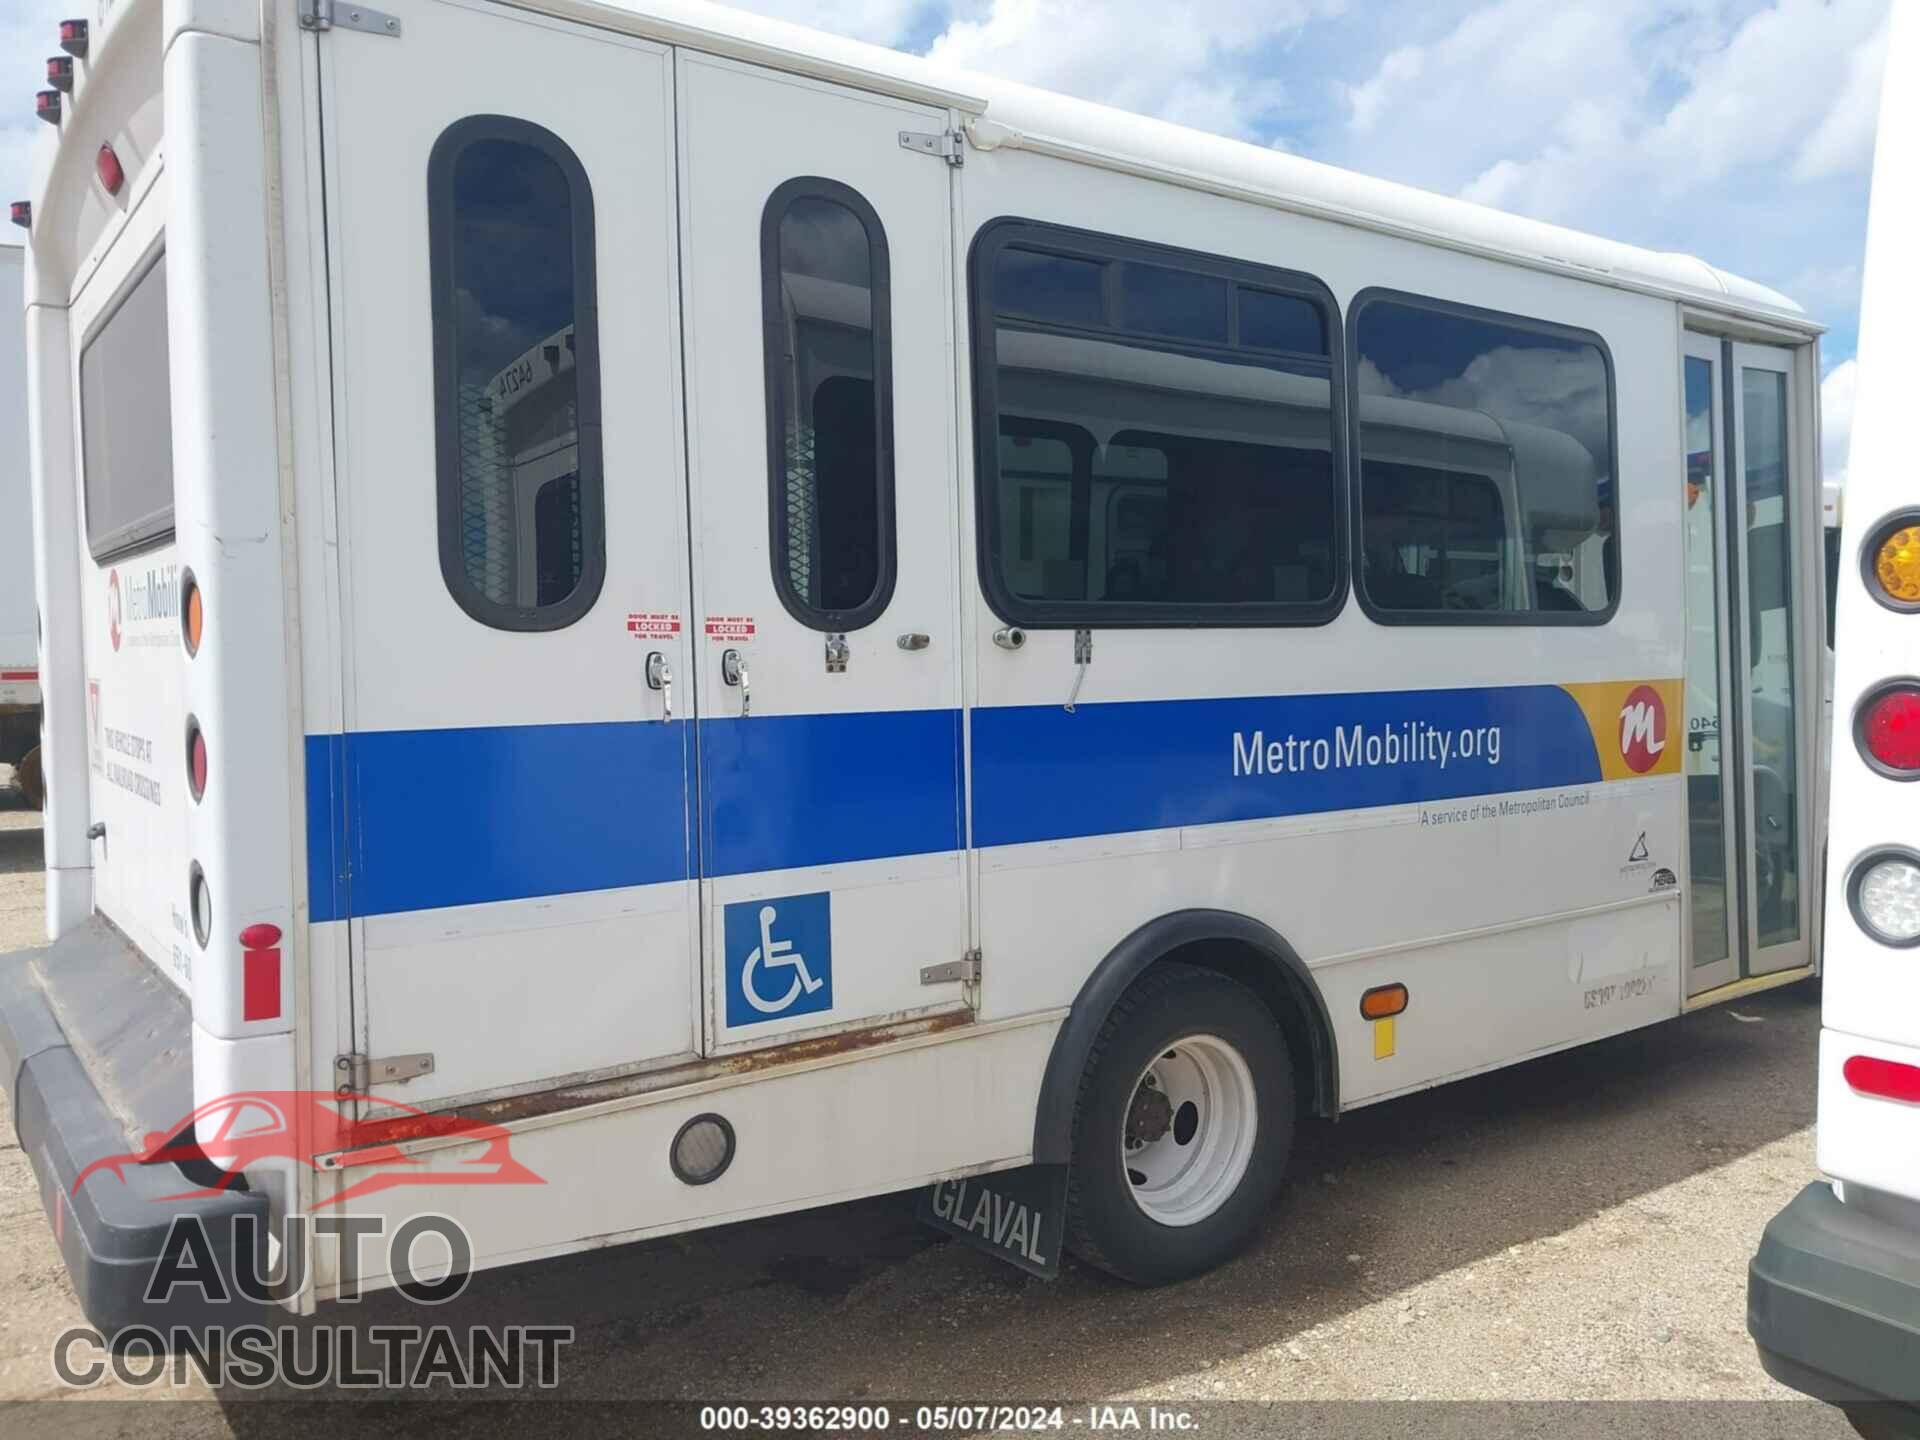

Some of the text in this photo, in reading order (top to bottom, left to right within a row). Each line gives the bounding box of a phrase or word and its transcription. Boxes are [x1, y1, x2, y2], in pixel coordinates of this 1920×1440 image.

[635, 623, 672, 632] LOCKED
[713, 625, 747, 634] LOCKED
[1420, 791, 1590, 826] A service of the Metropolitan Council
[932, 1177, 1046, 1265] GLAVAL
